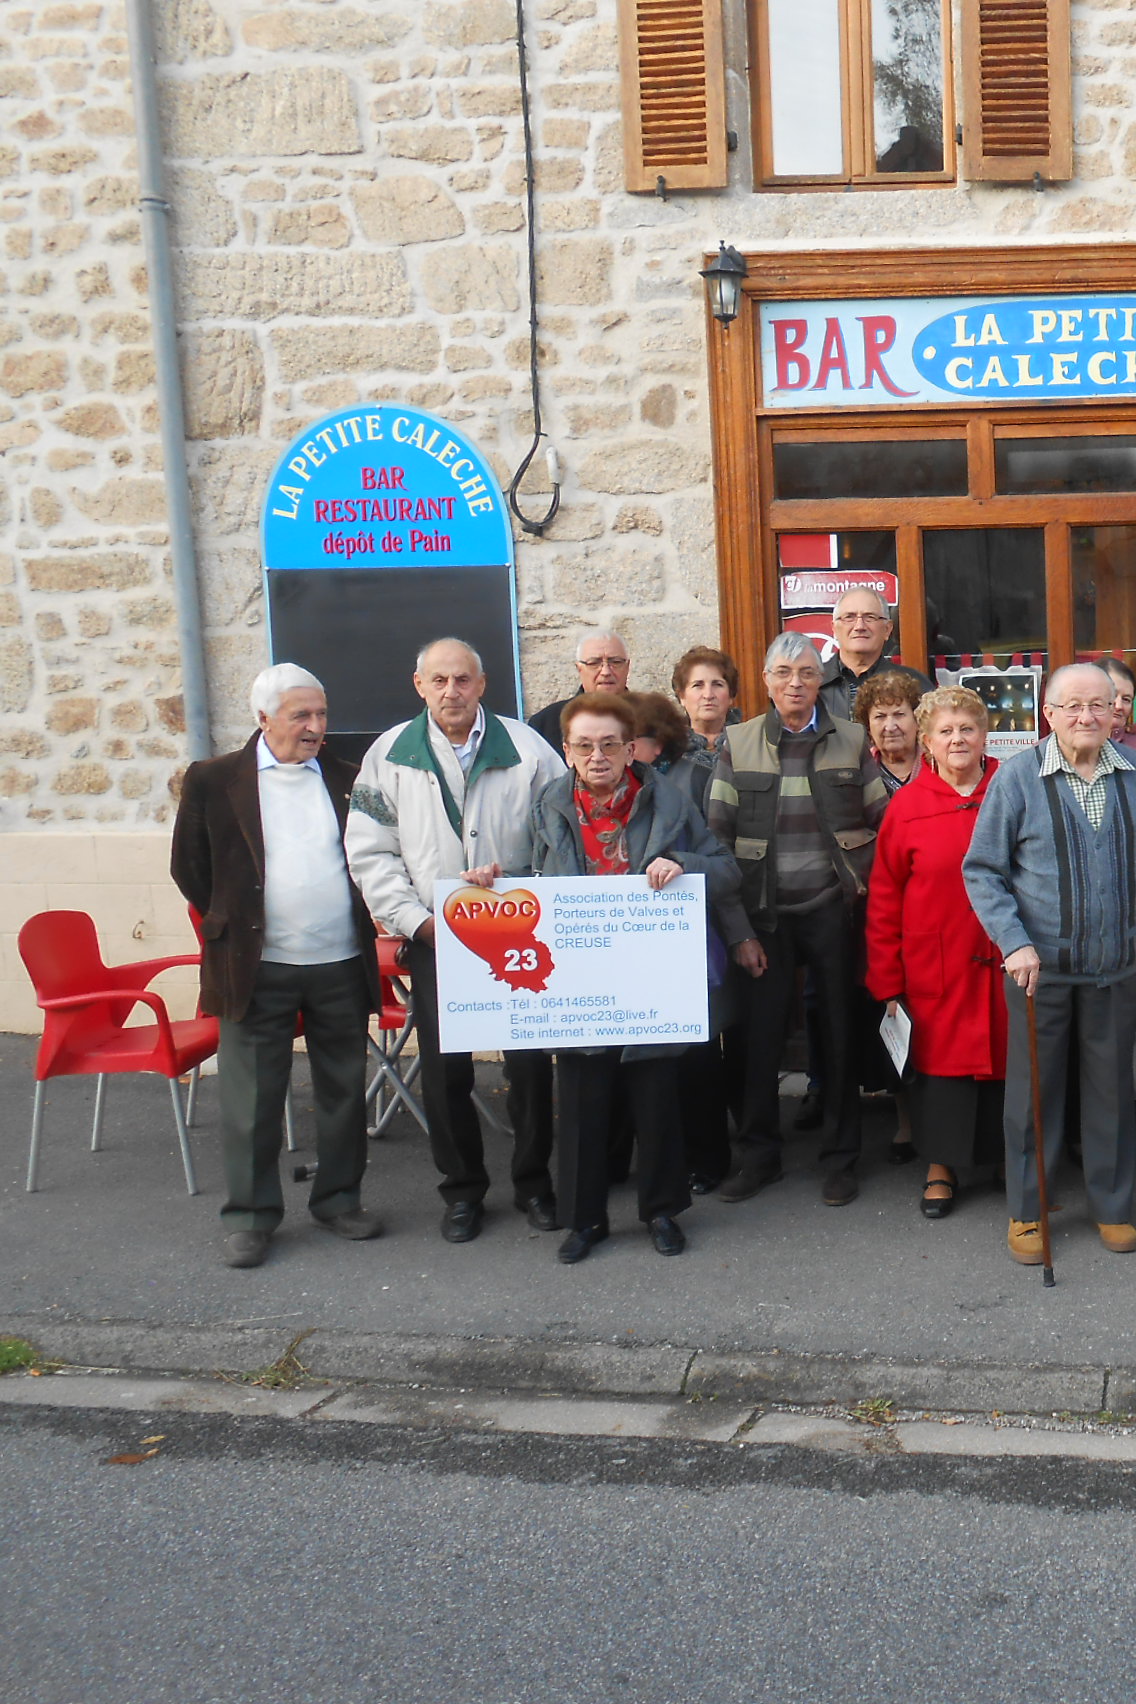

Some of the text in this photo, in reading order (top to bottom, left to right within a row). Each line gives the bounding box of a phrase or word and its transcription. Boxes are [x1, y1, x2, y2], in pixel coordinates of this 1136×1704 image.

[951, 313, 1006, 348] LA
[769, 315, 920, 397] BAR
[272, 415, 494, 520] LA PETITE CALECHE
[361, 466, 409, 491] BAR
[314, 497, 456, 524] RESTAURANT
[323, 530, 451, 559] dépôt de Pain
[553, 890, 698, 904] Association des Pontés,
[454, 900, 537, 920] APVOC
[554, 906, 684, 919] Porteurs de Valves et
[554, 920, 689, 935] Opérés du Cœur de la
[555, 937, 612, 949] CREUSE
[504, 949, 538, 972] 23
[447, 1001, 502, 1013] Contacts
[541, 996, 617, 1009] 0641465581
[510, 1013, 550, 1025] E-mail
[560, 1009, 658, 1024] apvoc23@live.fr
[511, 1028, 535, 1040] Site
[538, 1026, 584, 1039] internet
[595, 1022, 701, 1036] www.apvoc23.org
